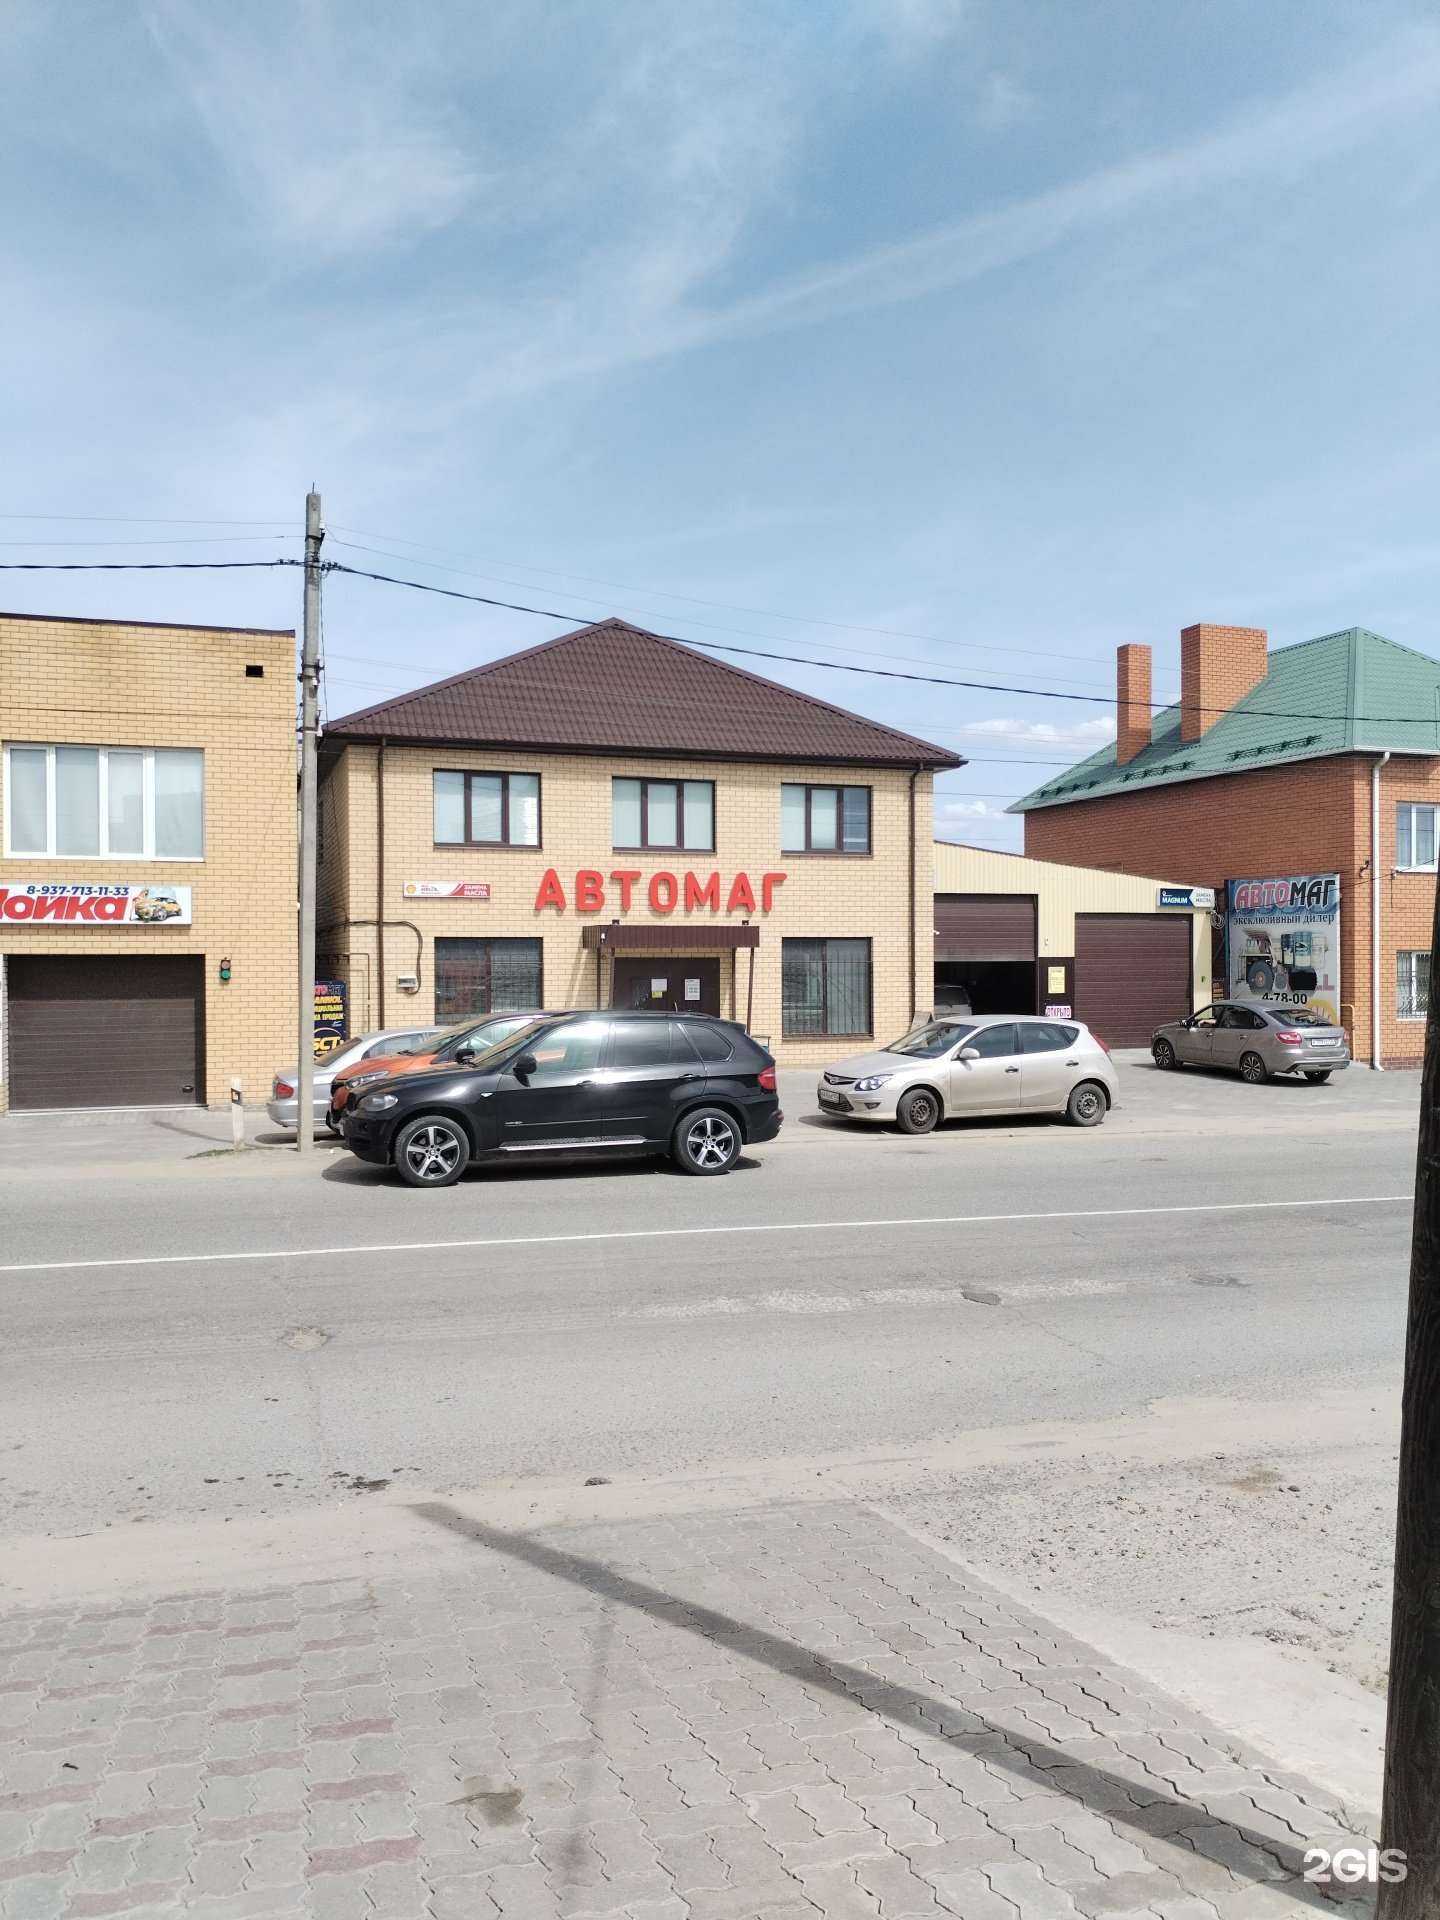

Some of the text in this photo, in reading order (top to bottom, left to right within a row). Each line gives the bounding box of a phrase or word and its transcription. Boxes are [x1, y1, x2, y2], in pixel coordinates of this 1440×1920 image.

[26, 885, 130, 896] 8-937-713-11-33
[535, 868, 787, 913] АВТОМАГ
[1235, 880, 1336, 912] АВТОМАГ
[1303, 914, 1335, 926] дилер
[1262, 992, 1307, 1005] 4-78-00
